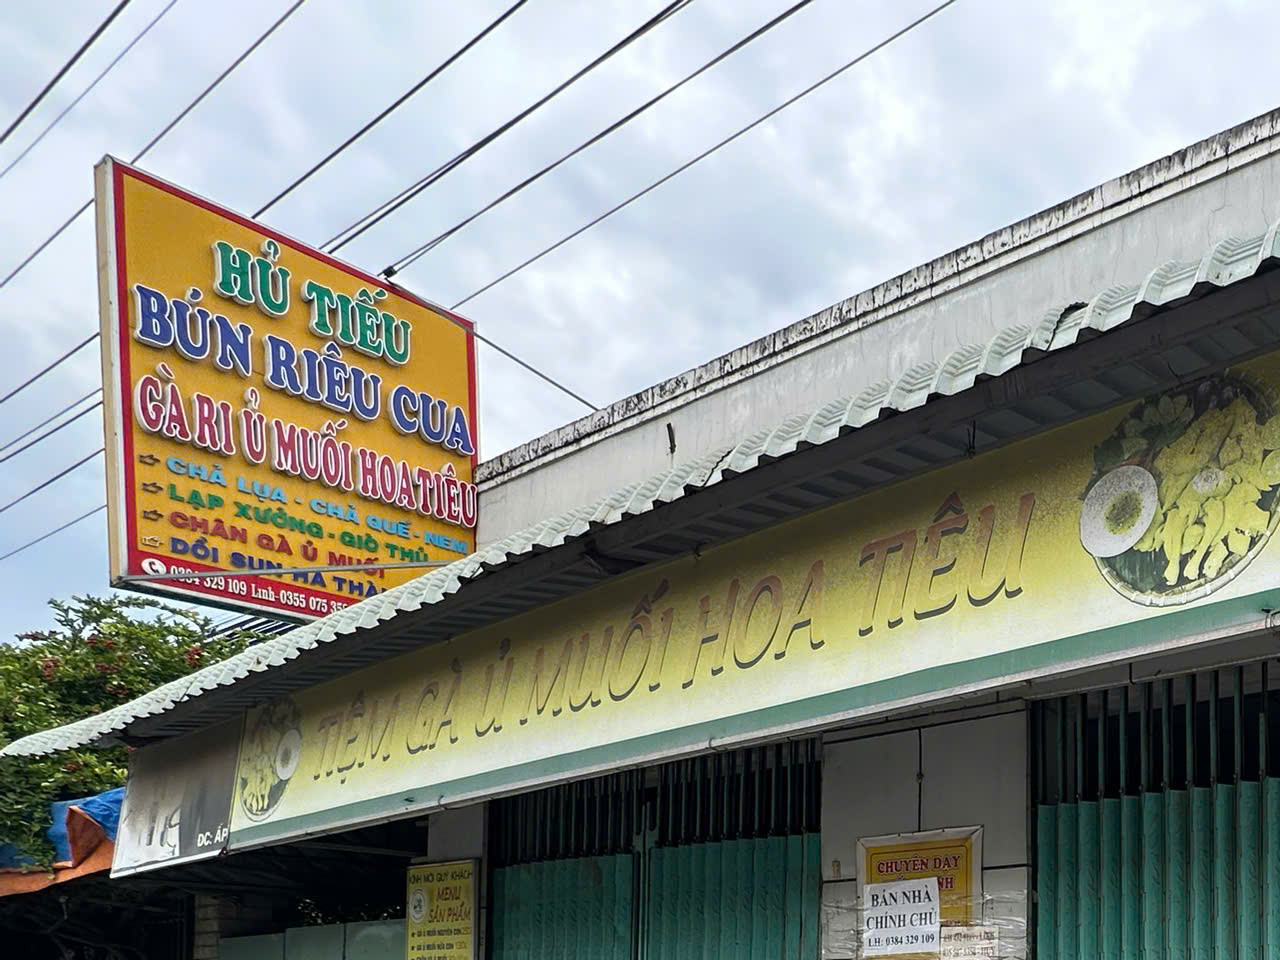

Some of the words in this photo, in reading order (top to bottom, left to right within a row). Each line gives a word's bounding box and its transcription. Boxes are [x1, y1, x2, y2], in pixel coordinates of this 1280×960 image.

[211, 238, 292, 318] HỦ
[302, 280, 413, 366] TIẾU
[131, 283, 253, 377] BÚN
[263, 333, 382, 421] RIÊU
[389, 385, 476, 456] CUA
[240, 386, 267, 465] Ủ
[271, 418, 355, 491] MUỐI
[169, 483, 225, 511] LẠP
[169, 511, 249, 544] CHÂN
[257, 532, 293, 556] GÀ
[424, 531, 468, 555] NEM
[226, 578, 247, 595] 109
[309, 596, 328, 612] 075
[313, 689, 400, 784] TIỆM
[406, 656, 464, 755] GÀ
[520, 577, 675, 725] MUỐI
[682, 559, 826, 690] HOA
[858, 491, 1036, 637] TIÊU
[877, 855, 929, 874] CHUYÊN
[933, 855, 961, 871] DẠY
[871, 889, 898, 908] BÁN
[902, 884, 932, 905] NHÀ
[866, 911, 906, 930] CHÍNH
[910, 907, 938, 927] CHỦ
[885, 934, 903, 946] 0384
[905, 934, 919, 945] 329
[921, 933, 935, 944] 109
